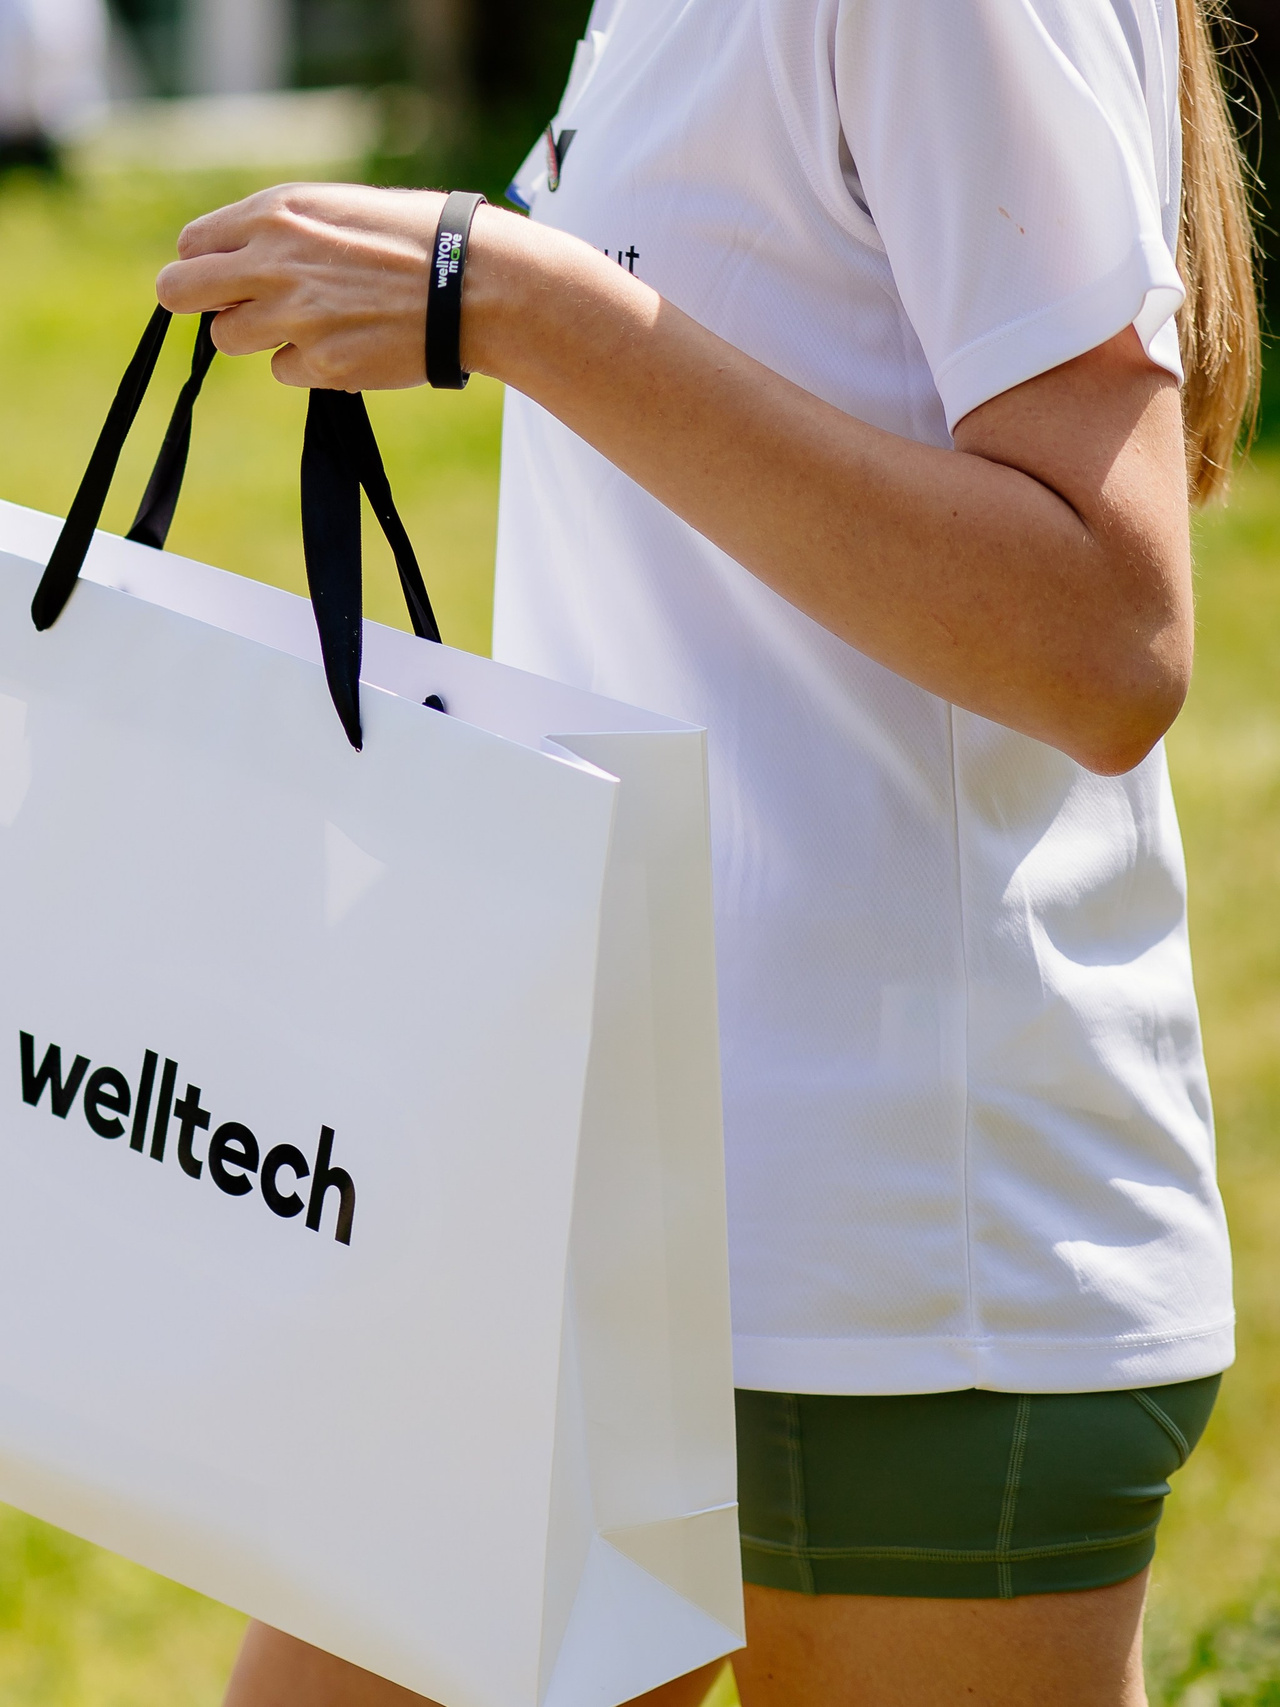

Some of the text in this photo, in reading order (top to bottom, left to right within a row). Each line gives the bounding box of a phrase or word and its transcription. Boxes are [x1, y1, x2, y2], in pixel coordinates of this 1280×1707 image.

[437, 232, 453, 288] wellYOU
[449, 233, 463, 273] move
[19, 1030, 356, 1246] welltech
